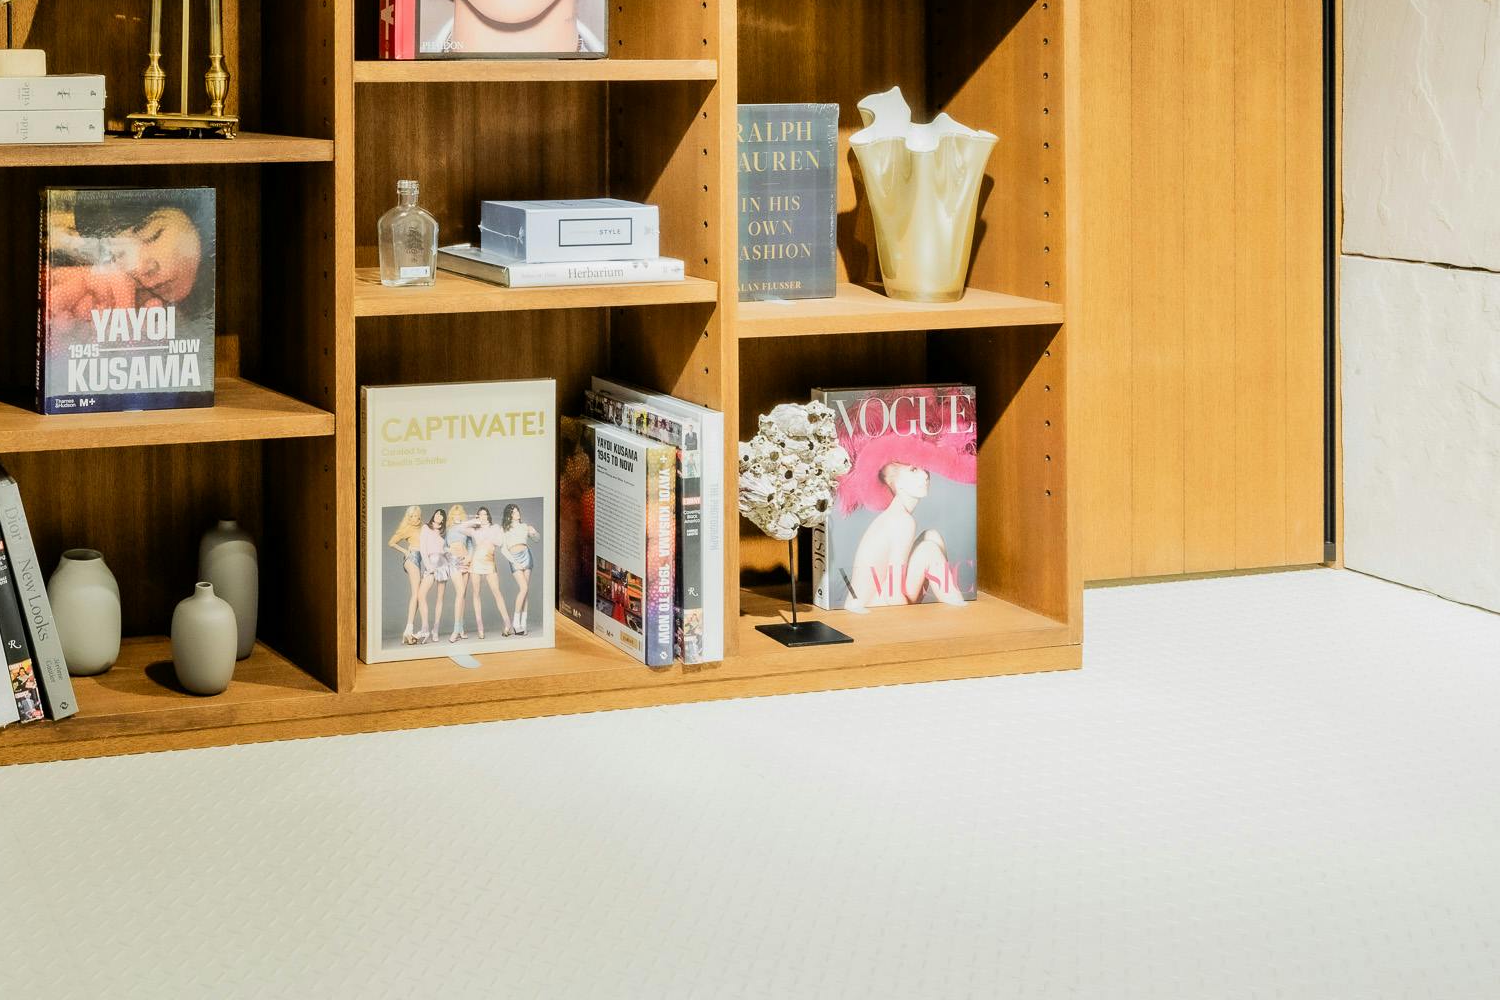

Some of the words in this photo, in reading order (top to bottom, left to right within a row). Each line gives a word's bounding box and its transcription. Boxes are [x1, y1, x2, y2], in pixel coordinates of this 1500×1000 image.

[738, 150, 821, 172] AUREN
[741, 196, 761, 213] IN
[769, 195, 801, 212] HIS
[748, 219, 794, 236] OWN
[739, 243, 812, 261] ASHION
[568, 267, 624, 280] Herbarium
[762, 280, 802, 291] FLUSSER
[91, 306, 176, 343] YAYOI
[68, 343, 100, 358] 1945
[168, 338, 200, 354] NOW
[67, 353, 201, 393] KUSAMA
[381, 411, 546, 443] CAPTIVATE!
[834, 394, 975, 438] VOGUE
[596, 436, 613, 452] YAYOI
[613, 442, 638, 462] KUSAMA
[597, 450, 611, 463] 1945
[611, 455, 619, 466] TO
[619, 458, 634, 473] NOW
[658, 468, 670, 502] YAYOI
[658, 506, 670, 557] KUSAMA
[4, 505, 22, 541] Dior
[20, 559, 36, 592] New
[28, 595, 49, 642] Looks
[658, 563, 671, 592] 1945
[658, 594, 670, 611] TO
[658, 614, 670, 644] NOW
